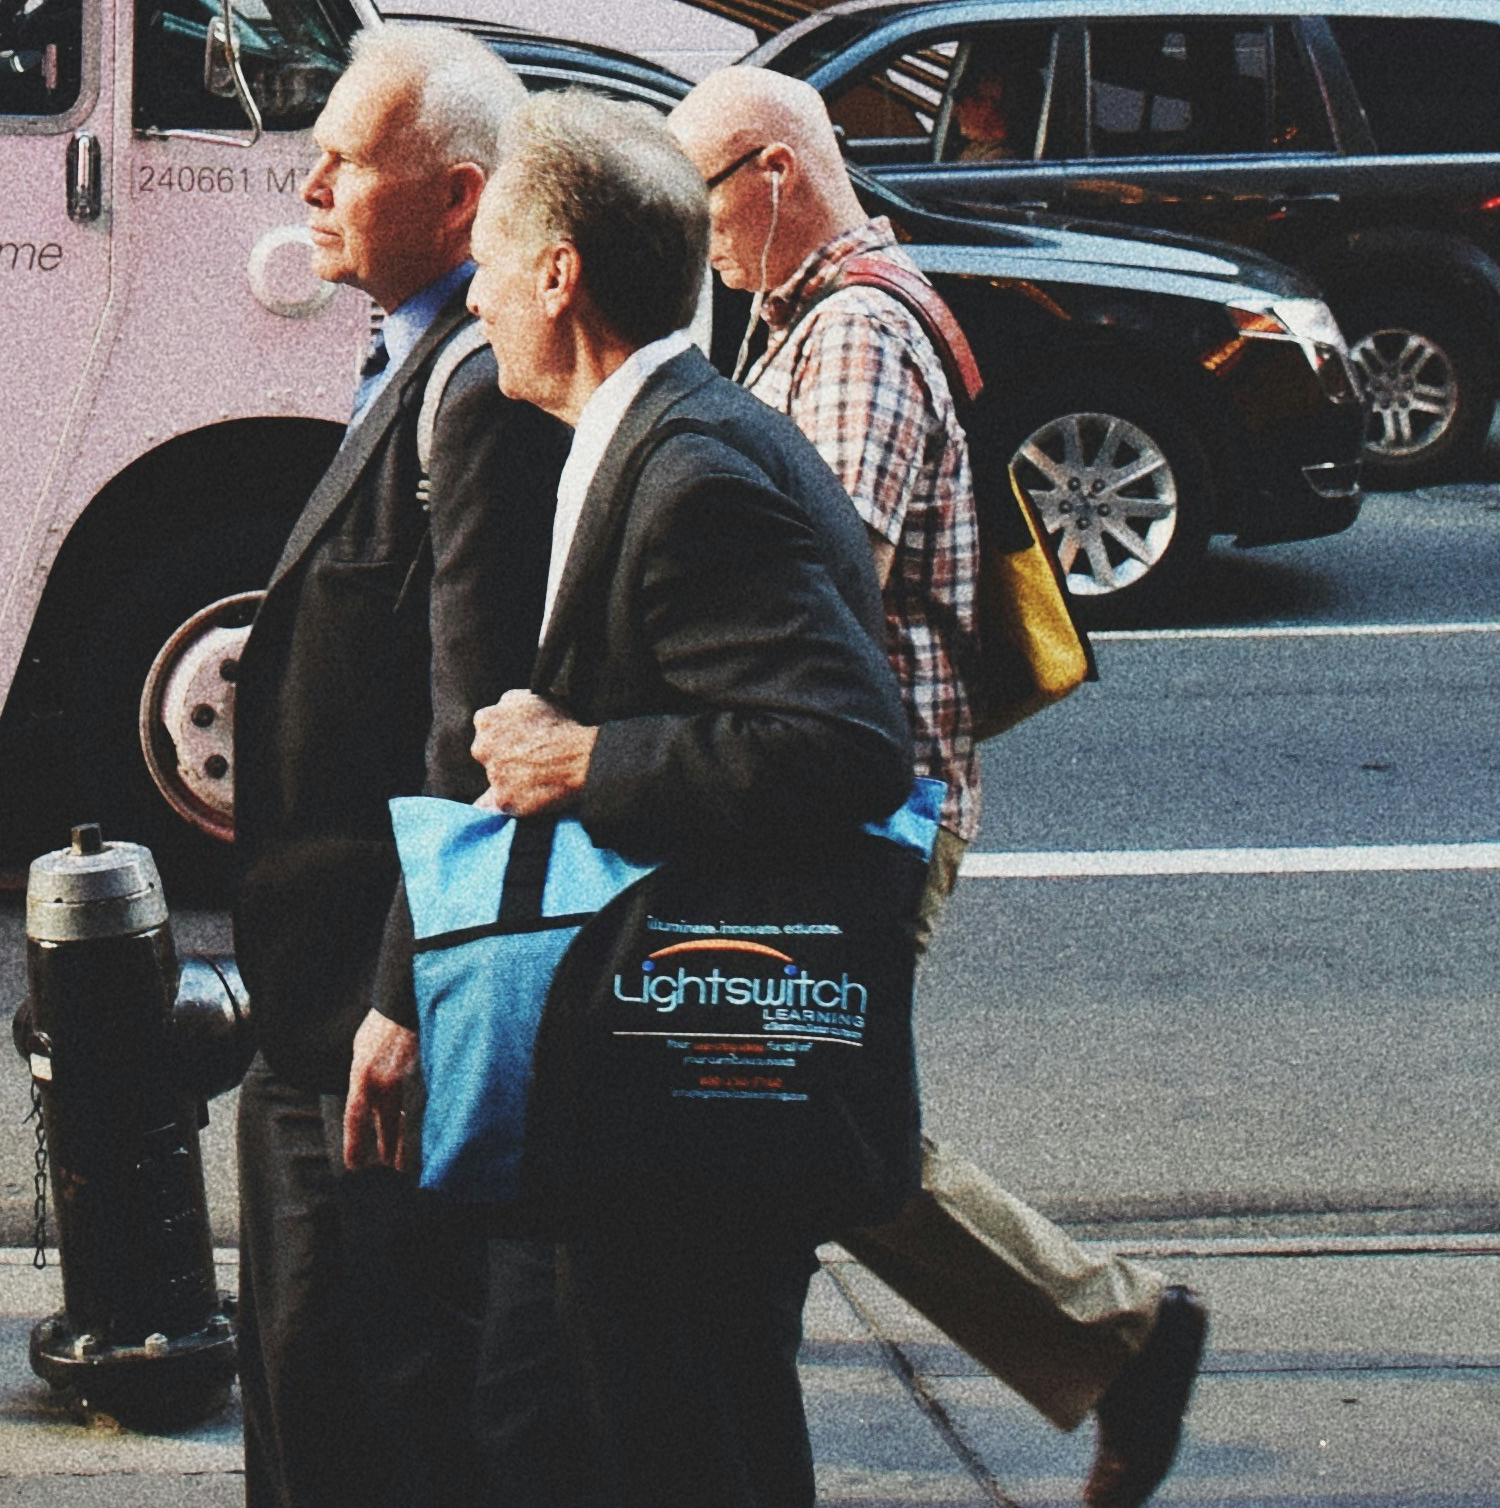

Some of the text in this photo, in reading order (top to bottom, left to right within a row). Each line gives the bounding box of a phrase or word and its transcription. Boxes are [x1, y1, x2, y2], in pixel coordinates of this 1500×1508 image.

[138, 166, 250, 194] 240661
[613, 962, 868, 1013] Lightswitch
[762, 1007, 866, 1029] LEARNING
